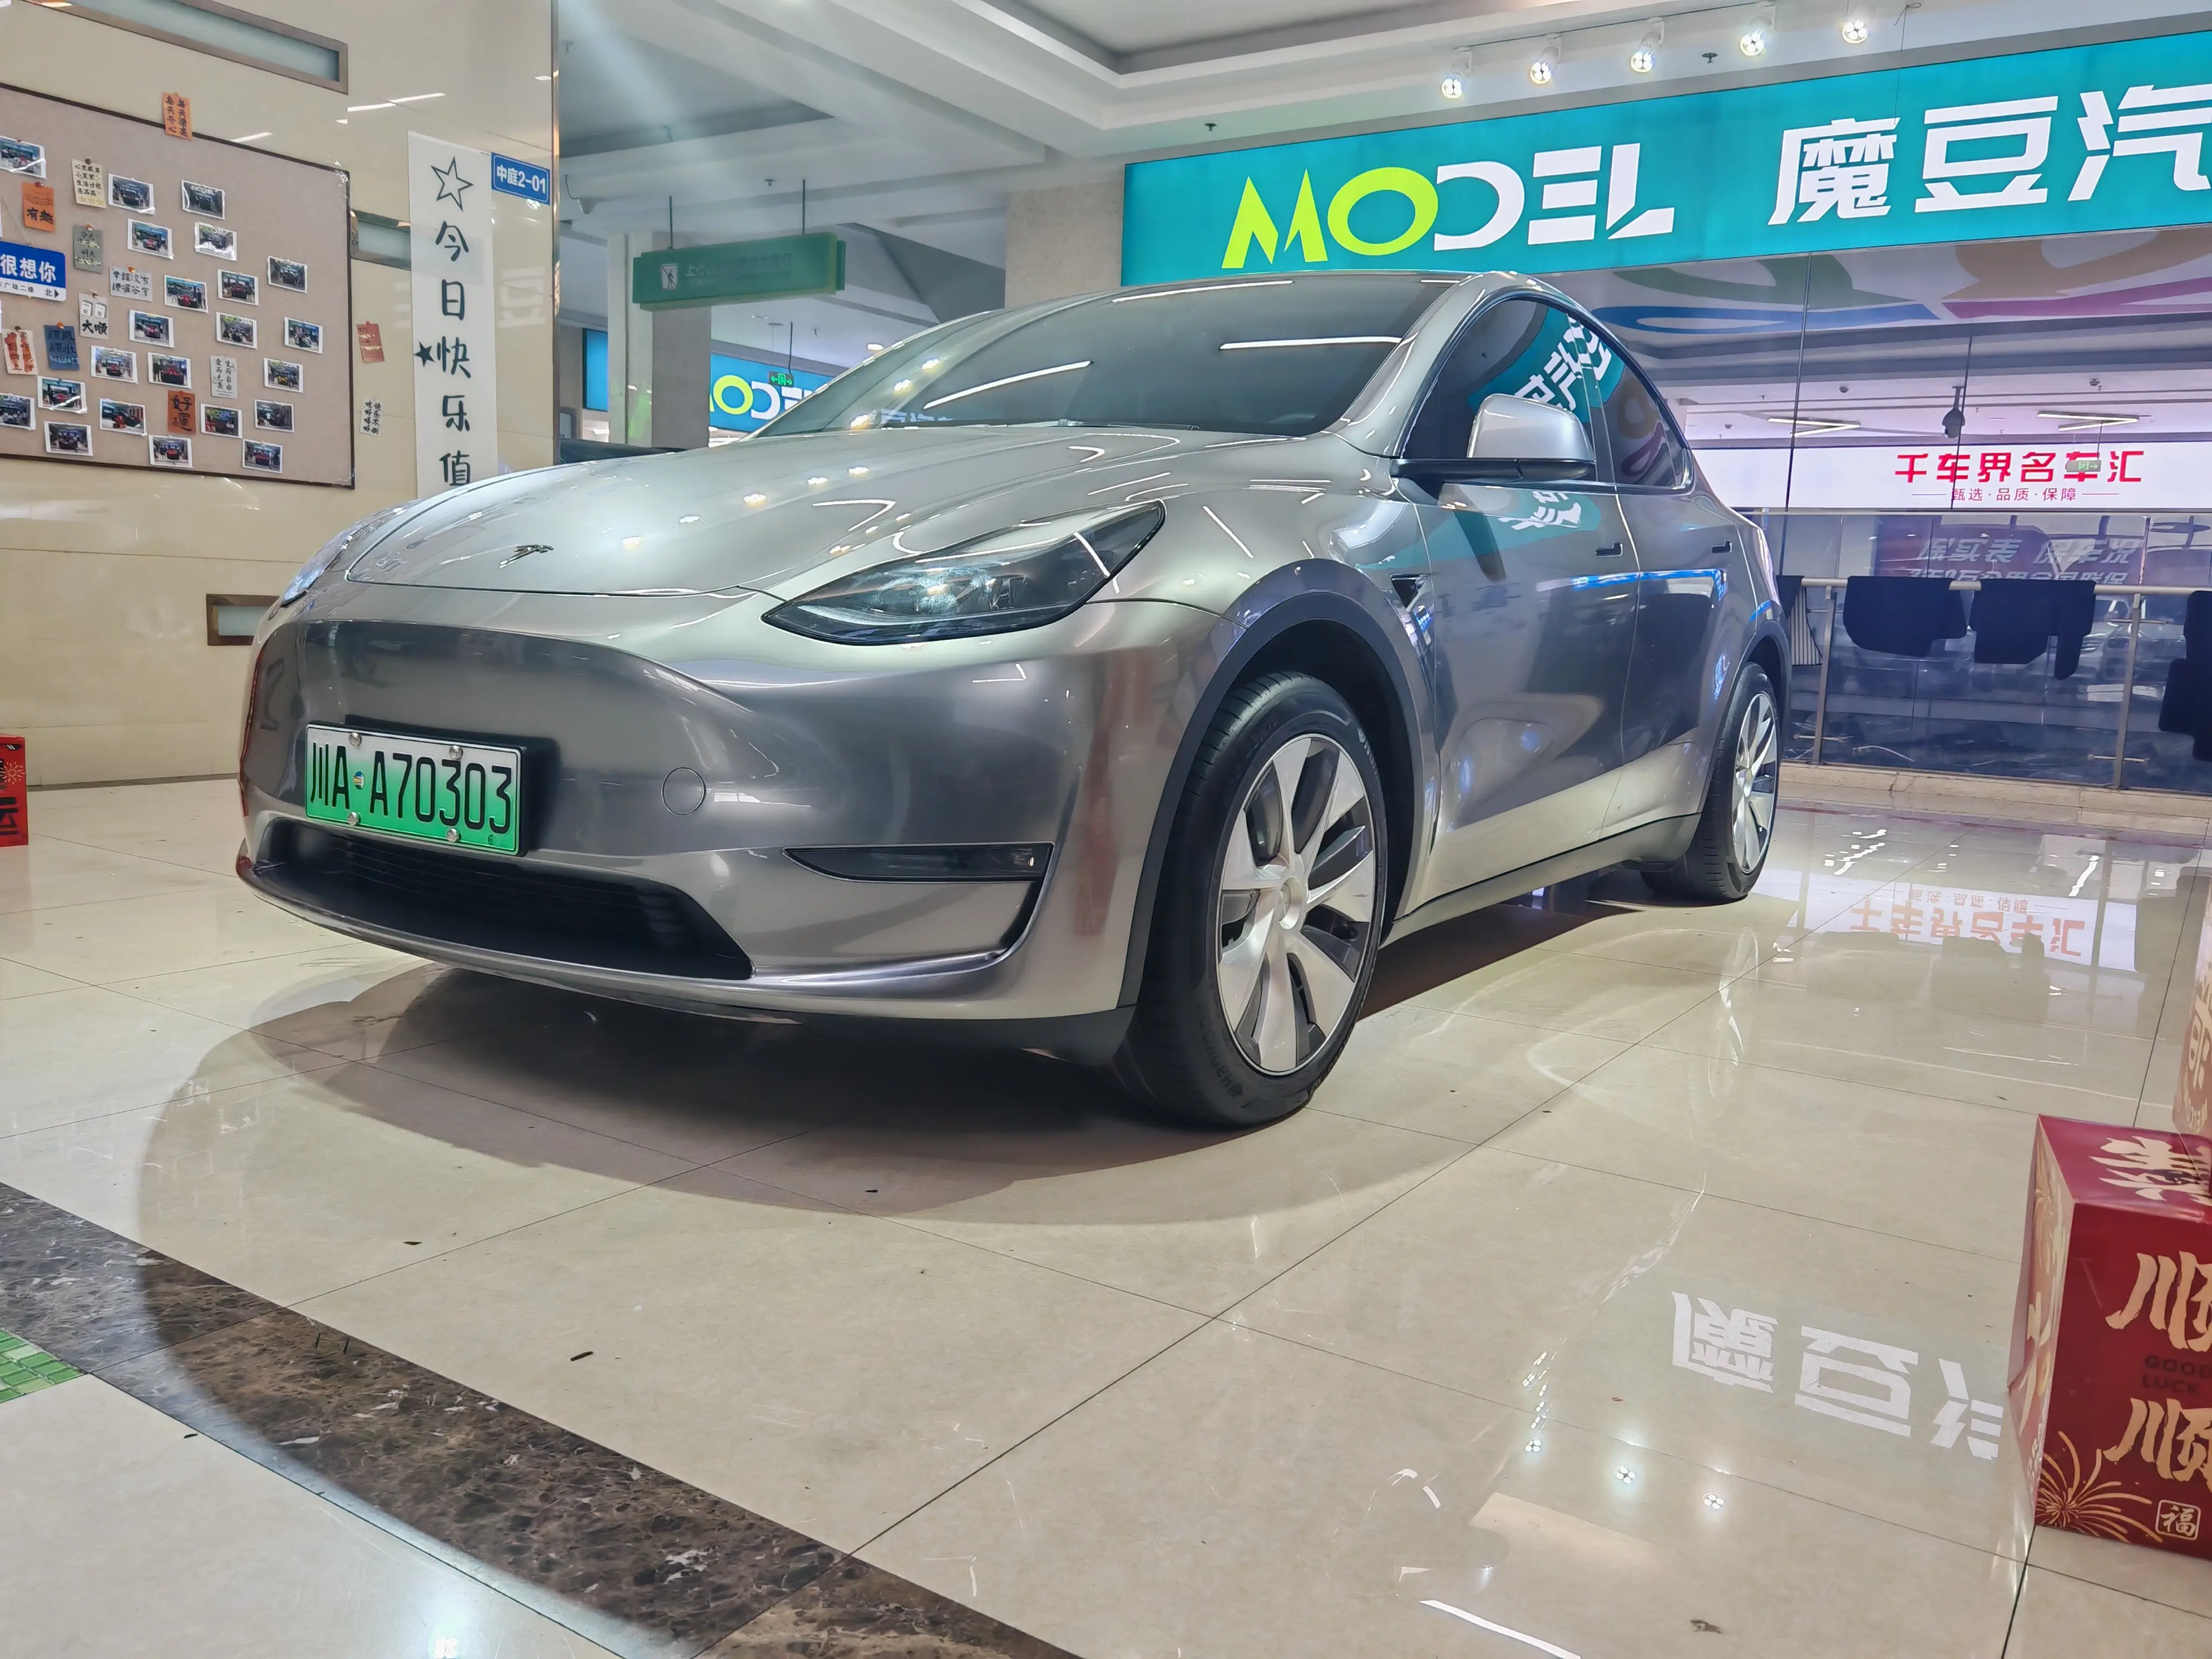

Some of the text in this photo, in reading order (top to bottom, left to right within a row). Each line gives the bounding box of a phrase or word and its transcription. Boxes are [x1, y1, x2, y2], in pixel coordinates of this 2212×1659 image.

[1768, 85, 2212, 225] 魔豆汽
[497, 164, 545, 194] 中庭2-01
[1221, 141, 1675, 268] MODEL
[0, 253, 57, 283] 很想你
[0, 281, 53, 297] 广场二楼 北
[435, 221, 471, 486] 今日快乐值
[1894, 450, 2144, 483] 千车界名车汇
[2160, 1503, 2197, 1538] 福
